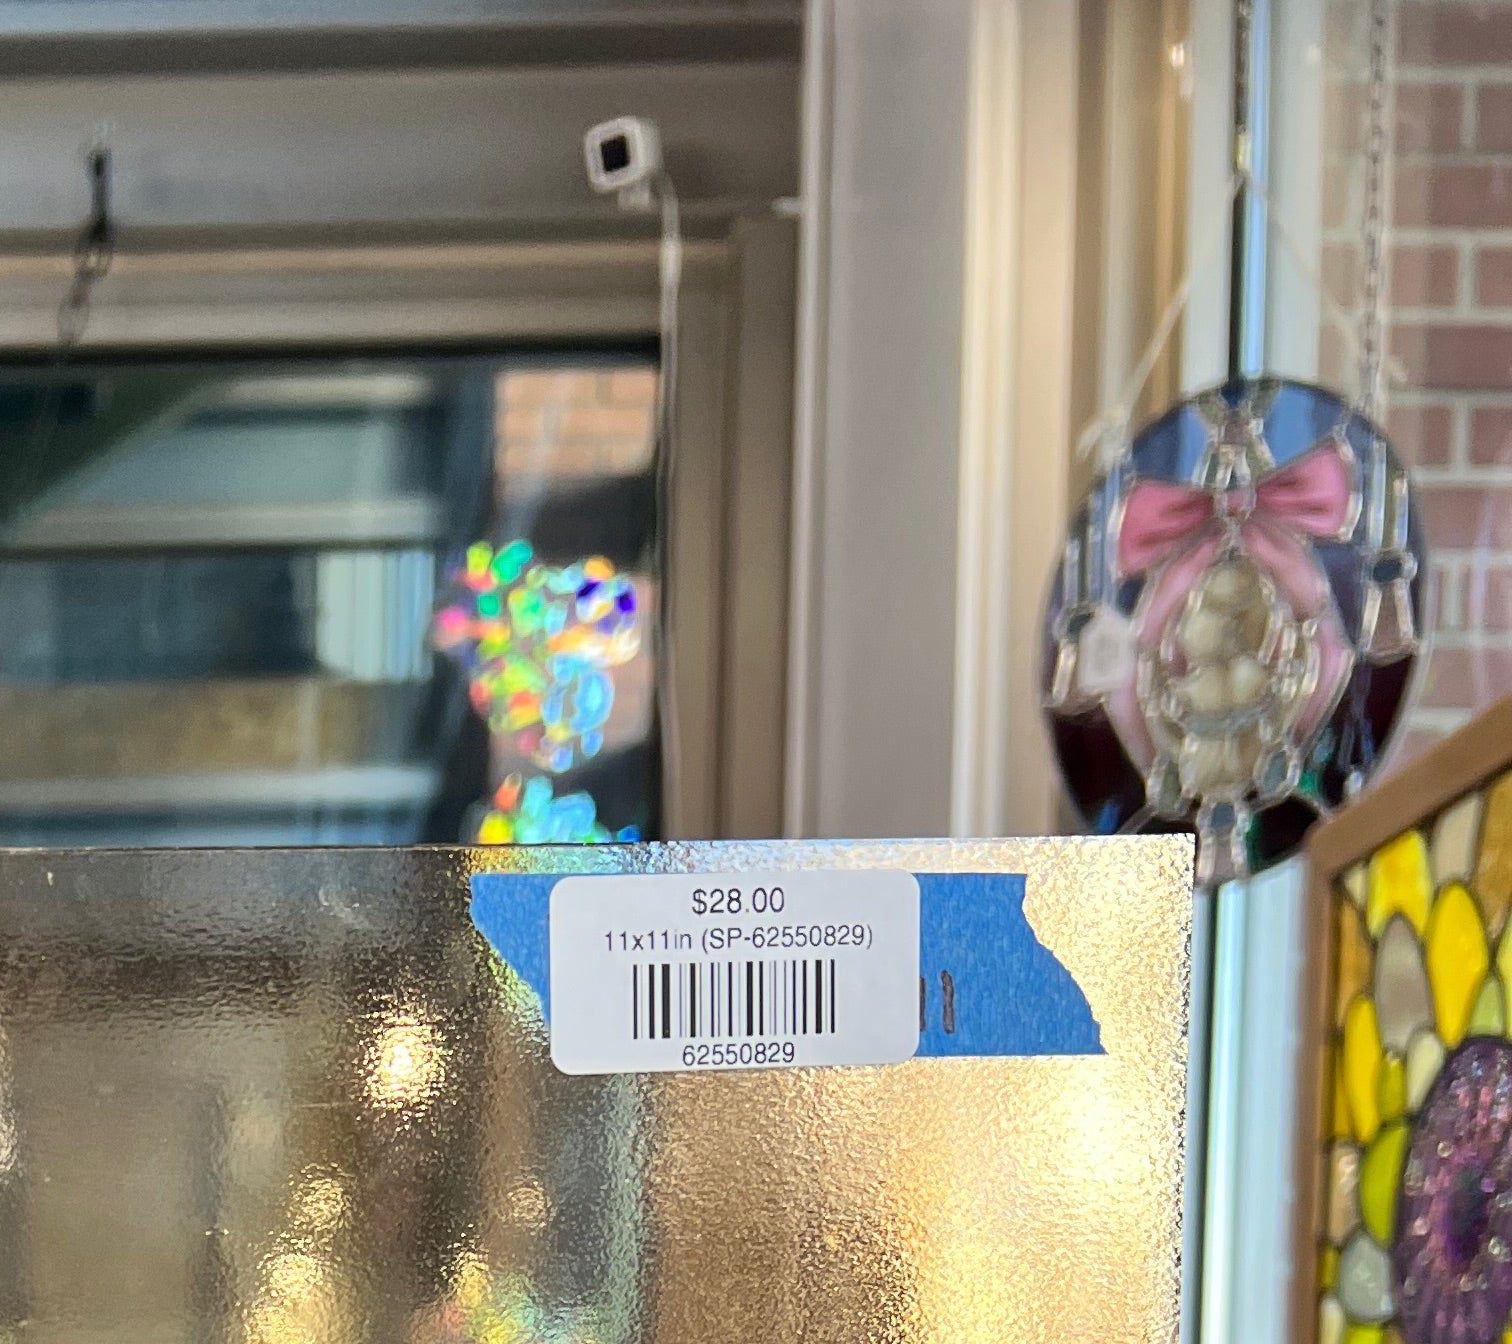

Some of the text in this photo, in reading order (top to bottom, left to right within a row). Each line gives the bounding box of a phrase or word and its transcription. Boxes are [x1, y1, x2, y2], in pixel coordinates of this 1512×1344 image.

[691, 885, 786, 916] $28.00
[604, 923, 874, 954] 11x11in (SP-62550829)
[681, 1040, 796, 1067] 62550829
